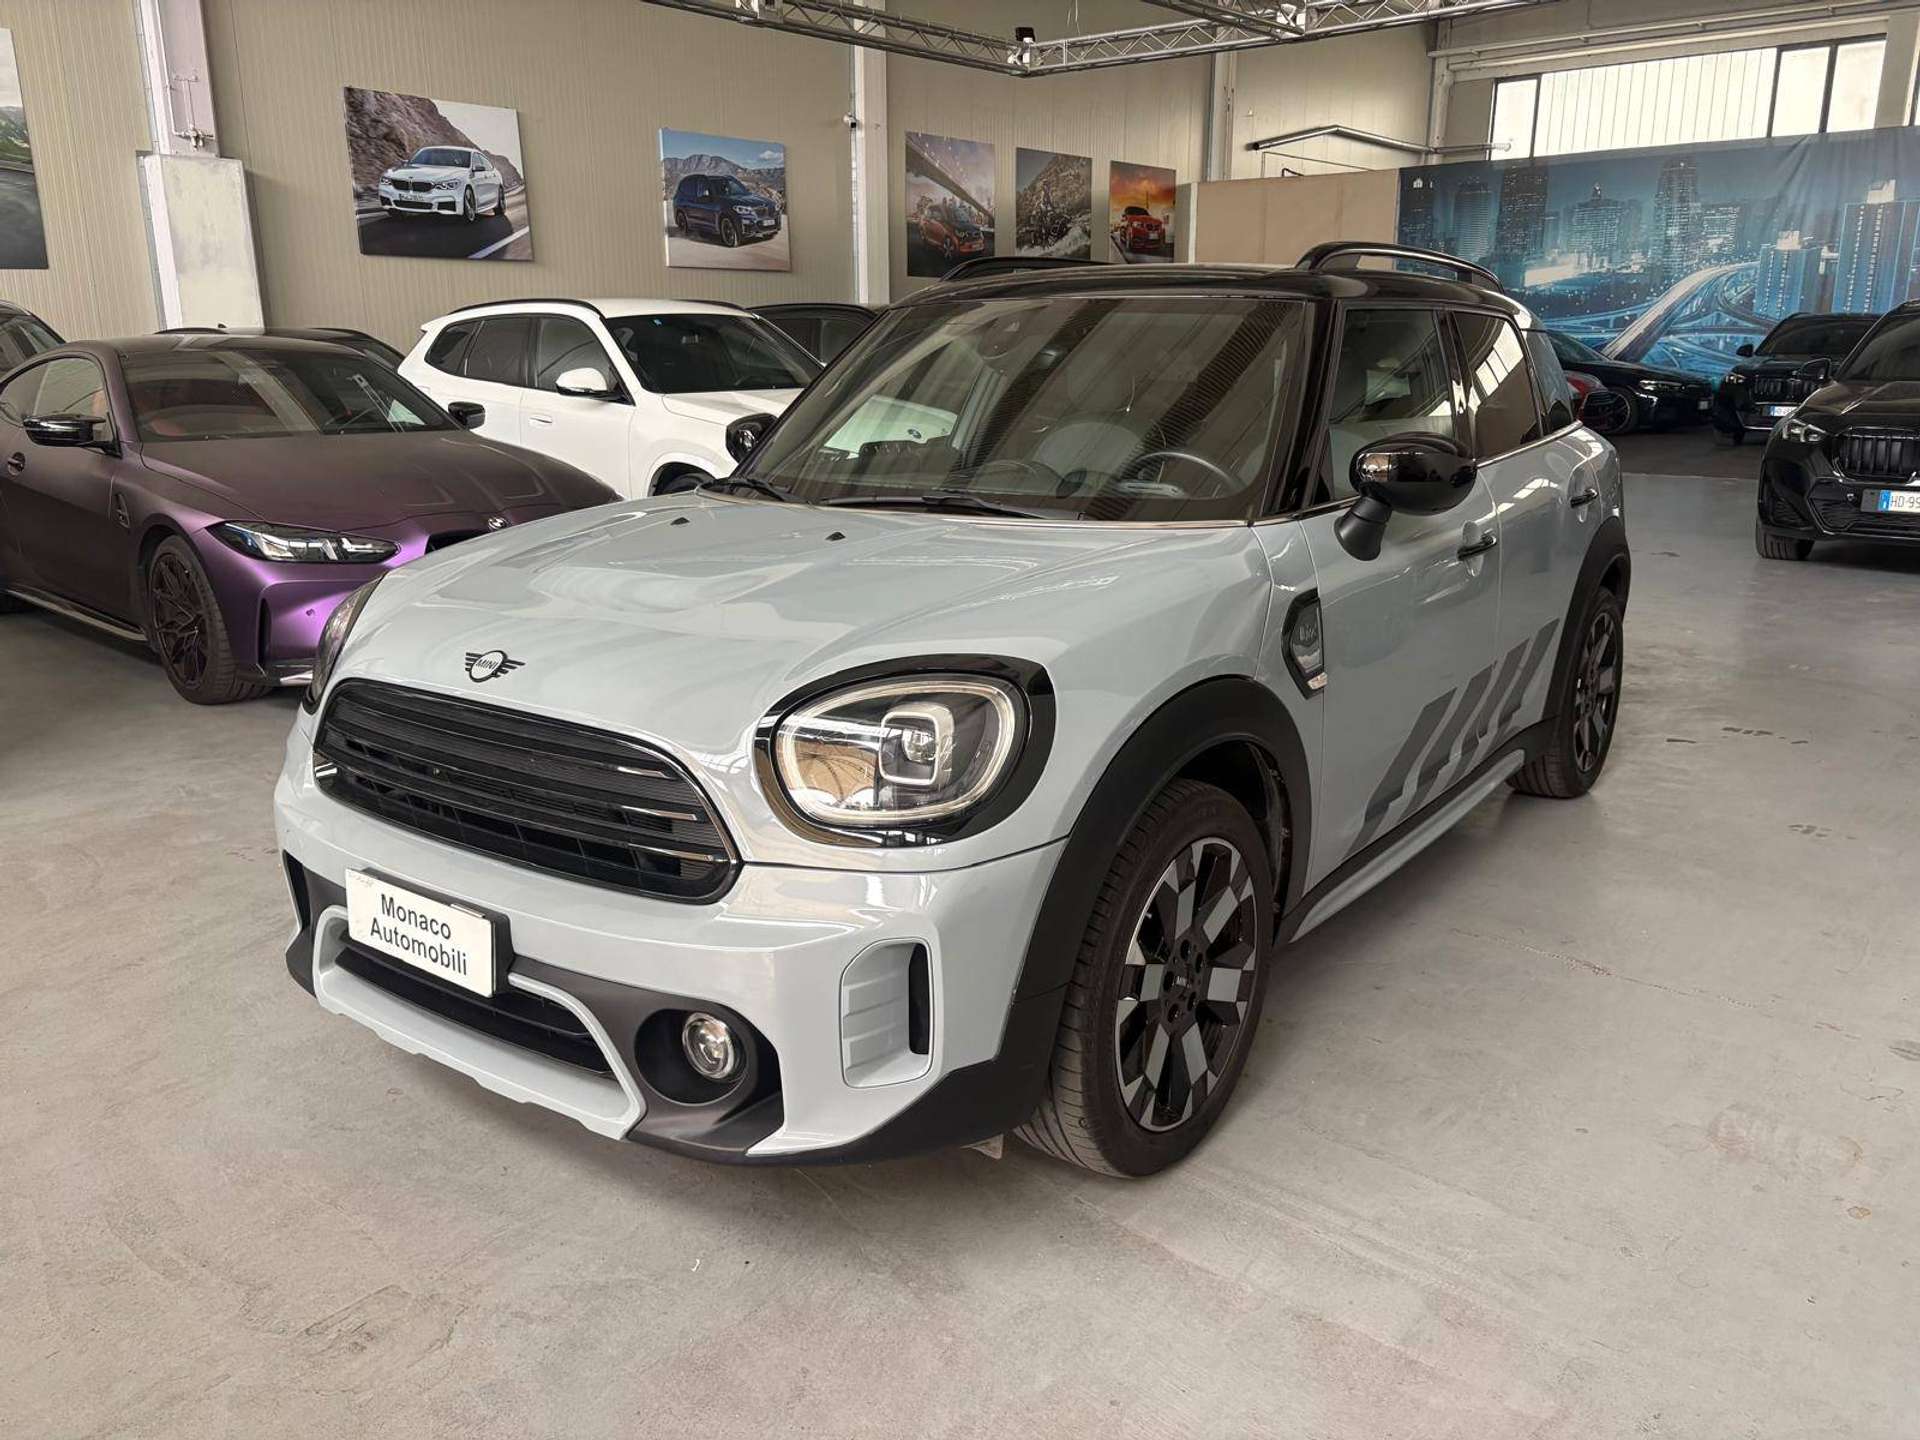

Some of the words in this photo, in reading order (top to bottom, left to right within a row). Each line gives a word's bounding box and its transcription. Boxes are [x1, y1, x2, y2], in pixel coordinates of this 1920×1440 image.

[475, 659, 500, 670] MINI
[381, 894, 452, 940] Monaco
[370, 917, 467, 976] Automobili
